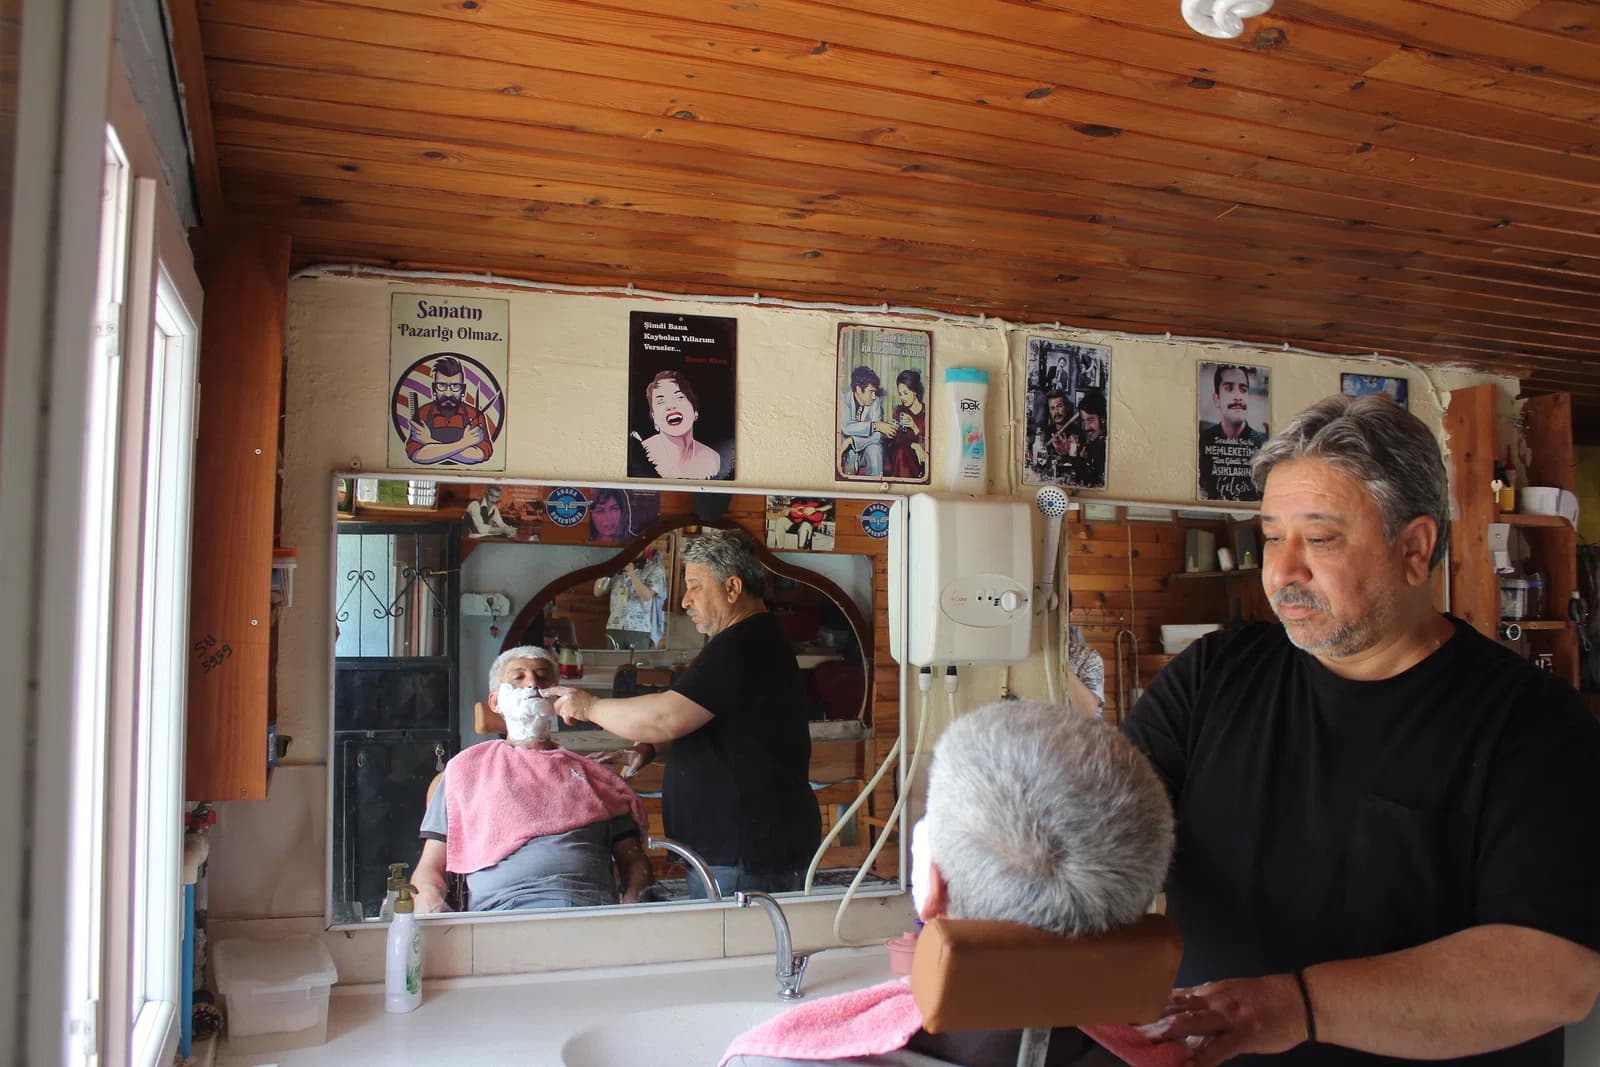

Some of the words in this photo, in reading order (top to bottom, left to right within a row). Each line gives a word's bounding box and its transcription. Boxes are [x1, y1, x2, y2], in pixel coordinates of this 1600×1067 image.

[417, 300, 482, 321] Sanatın
[668, 323, 688, 331] Bana
[457, 327, 503, 342] Olmaz.
[643, 333, 680, 341] Kaybolan
[960, 399, 981, 412] ipek
